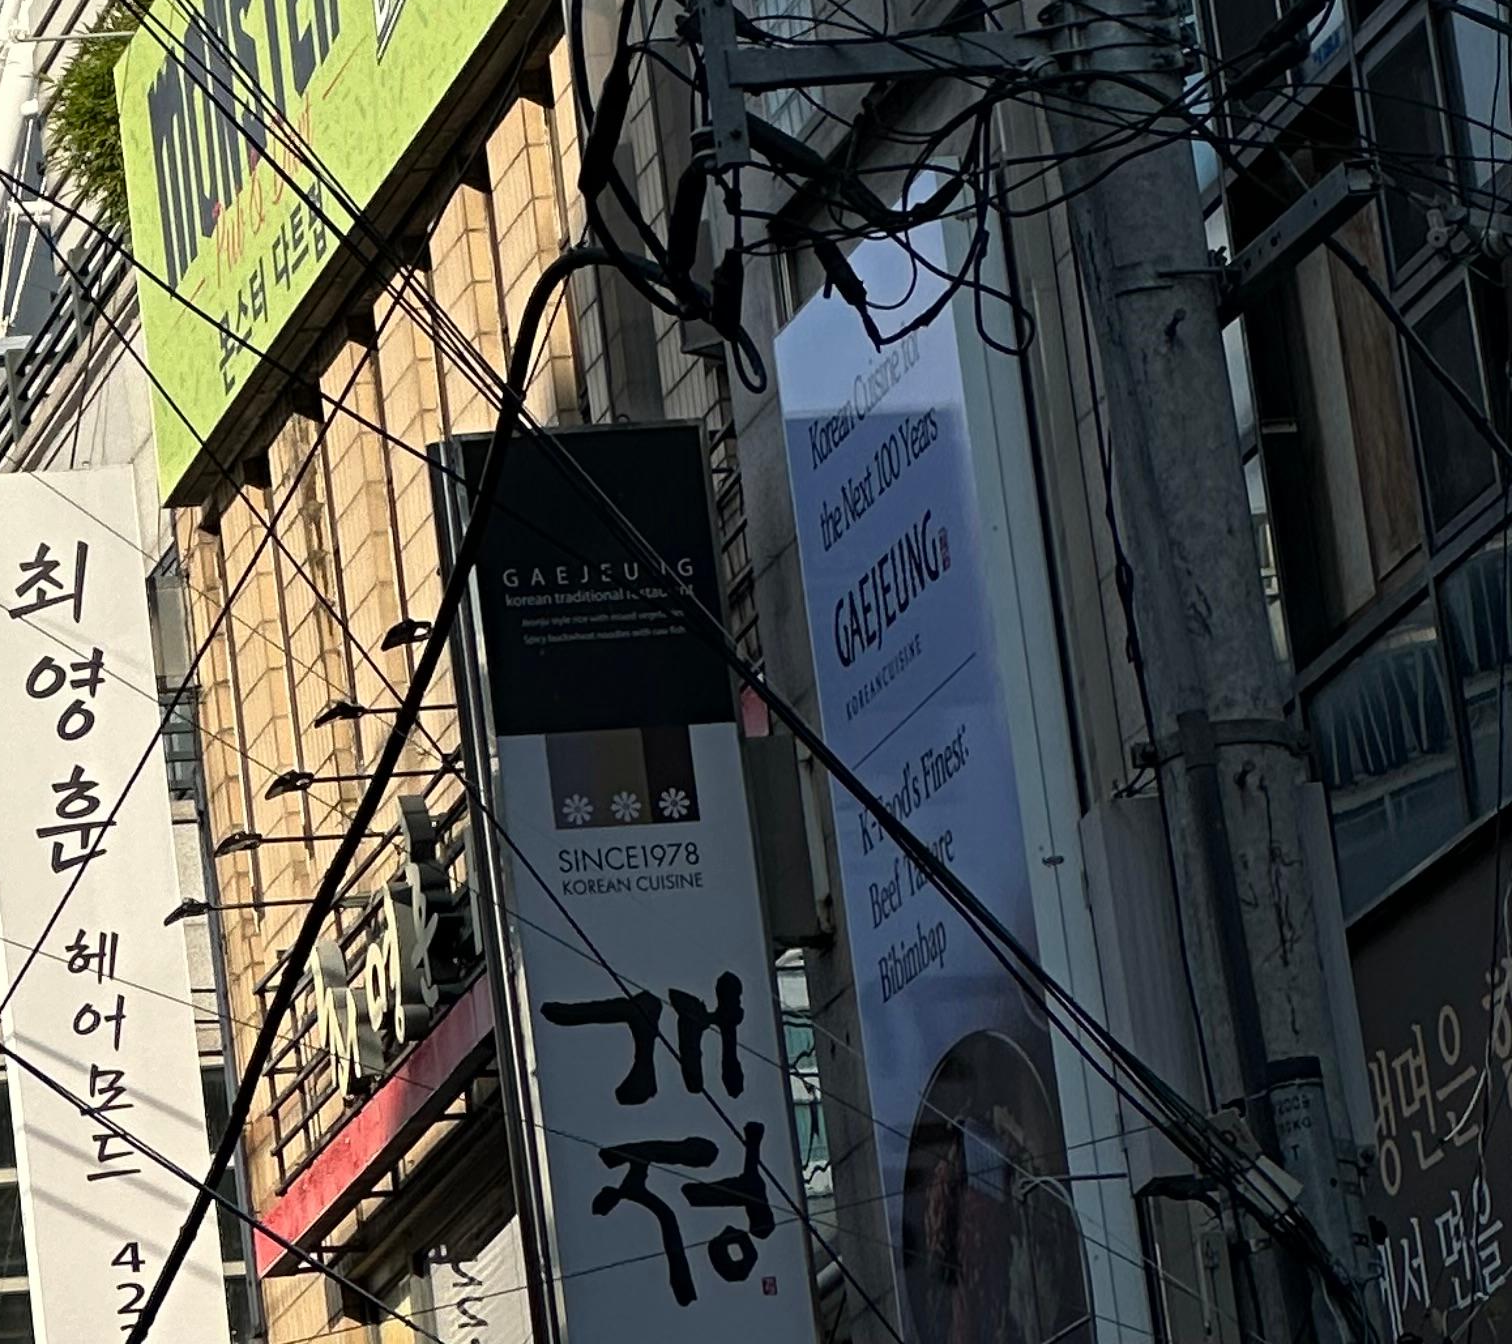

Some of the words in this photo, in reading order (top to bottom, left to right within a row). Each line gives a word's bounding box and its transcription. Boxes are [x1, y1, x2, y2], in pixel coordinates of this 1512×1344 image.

[220, 257, 268, 396] 몬스터
[808, 399, 854, 470] Korean
[852, 356, 899, 421] Cuisine
[820, 499, 844, 552] the
[840, 469, 876, 531] Next
[874, 432, 903, 497] 100
[899, 406, 940, 473] Years
[505, 593, 552, 607] korean
[554, 588, 624, 605] traditional
[834, 510, 940, 668] GAEJEUNG
[9, 541, 117, 873] 최영훈
[563, 878, 632, 896] KOREAN
[636, 872, 703, 892] CUISINE
[869, 857, 903, 928] Beef
[878, 920, 947, 1003] Bibimbap
[65, 929, 141, 1181] 헤어모드
[111, 1242, 146, 1334] 42
